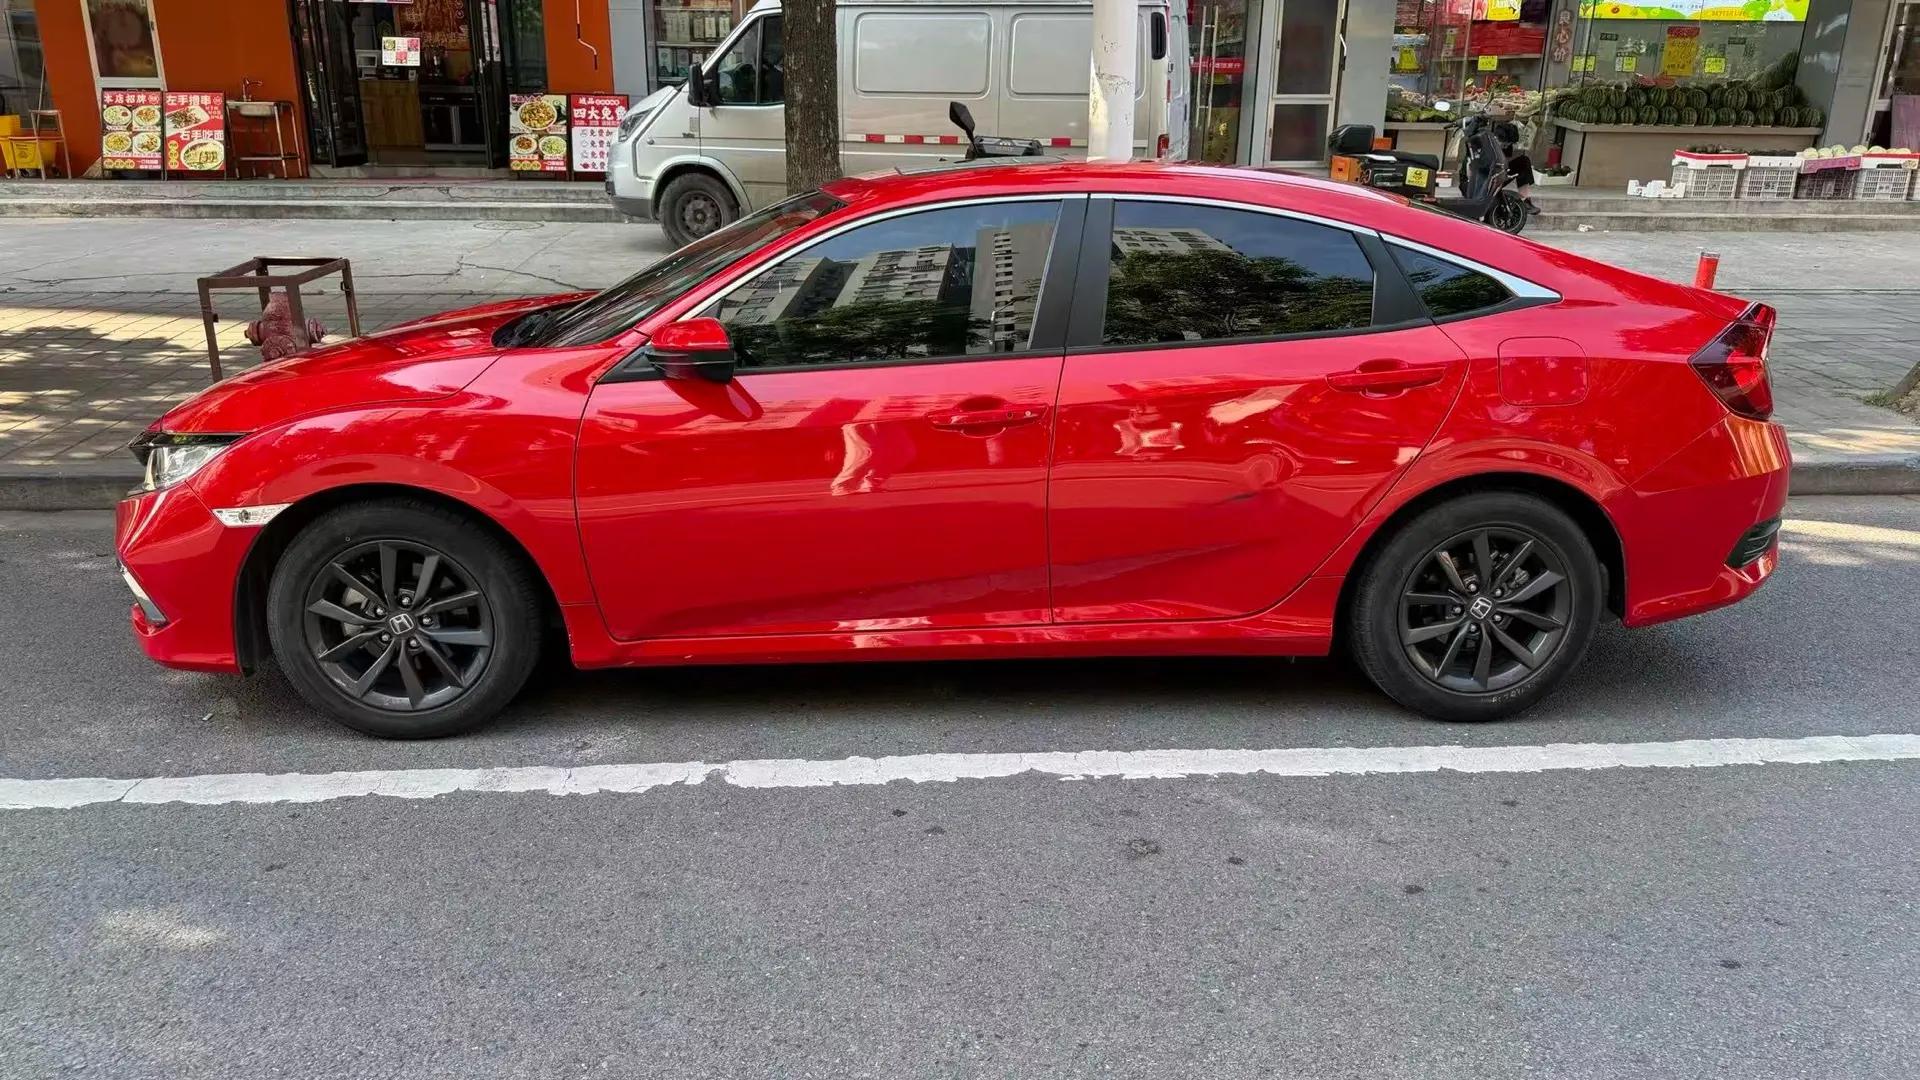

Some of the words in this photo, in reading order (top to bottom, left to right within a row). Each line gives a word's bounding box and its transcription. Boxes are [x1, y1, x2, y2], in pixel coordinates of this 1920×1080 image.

[104, 93, 147, 104] 本店招牌
[166, 94, 211, 106] 左手撸串
[180, 129, 225, 141] 右手吃面
